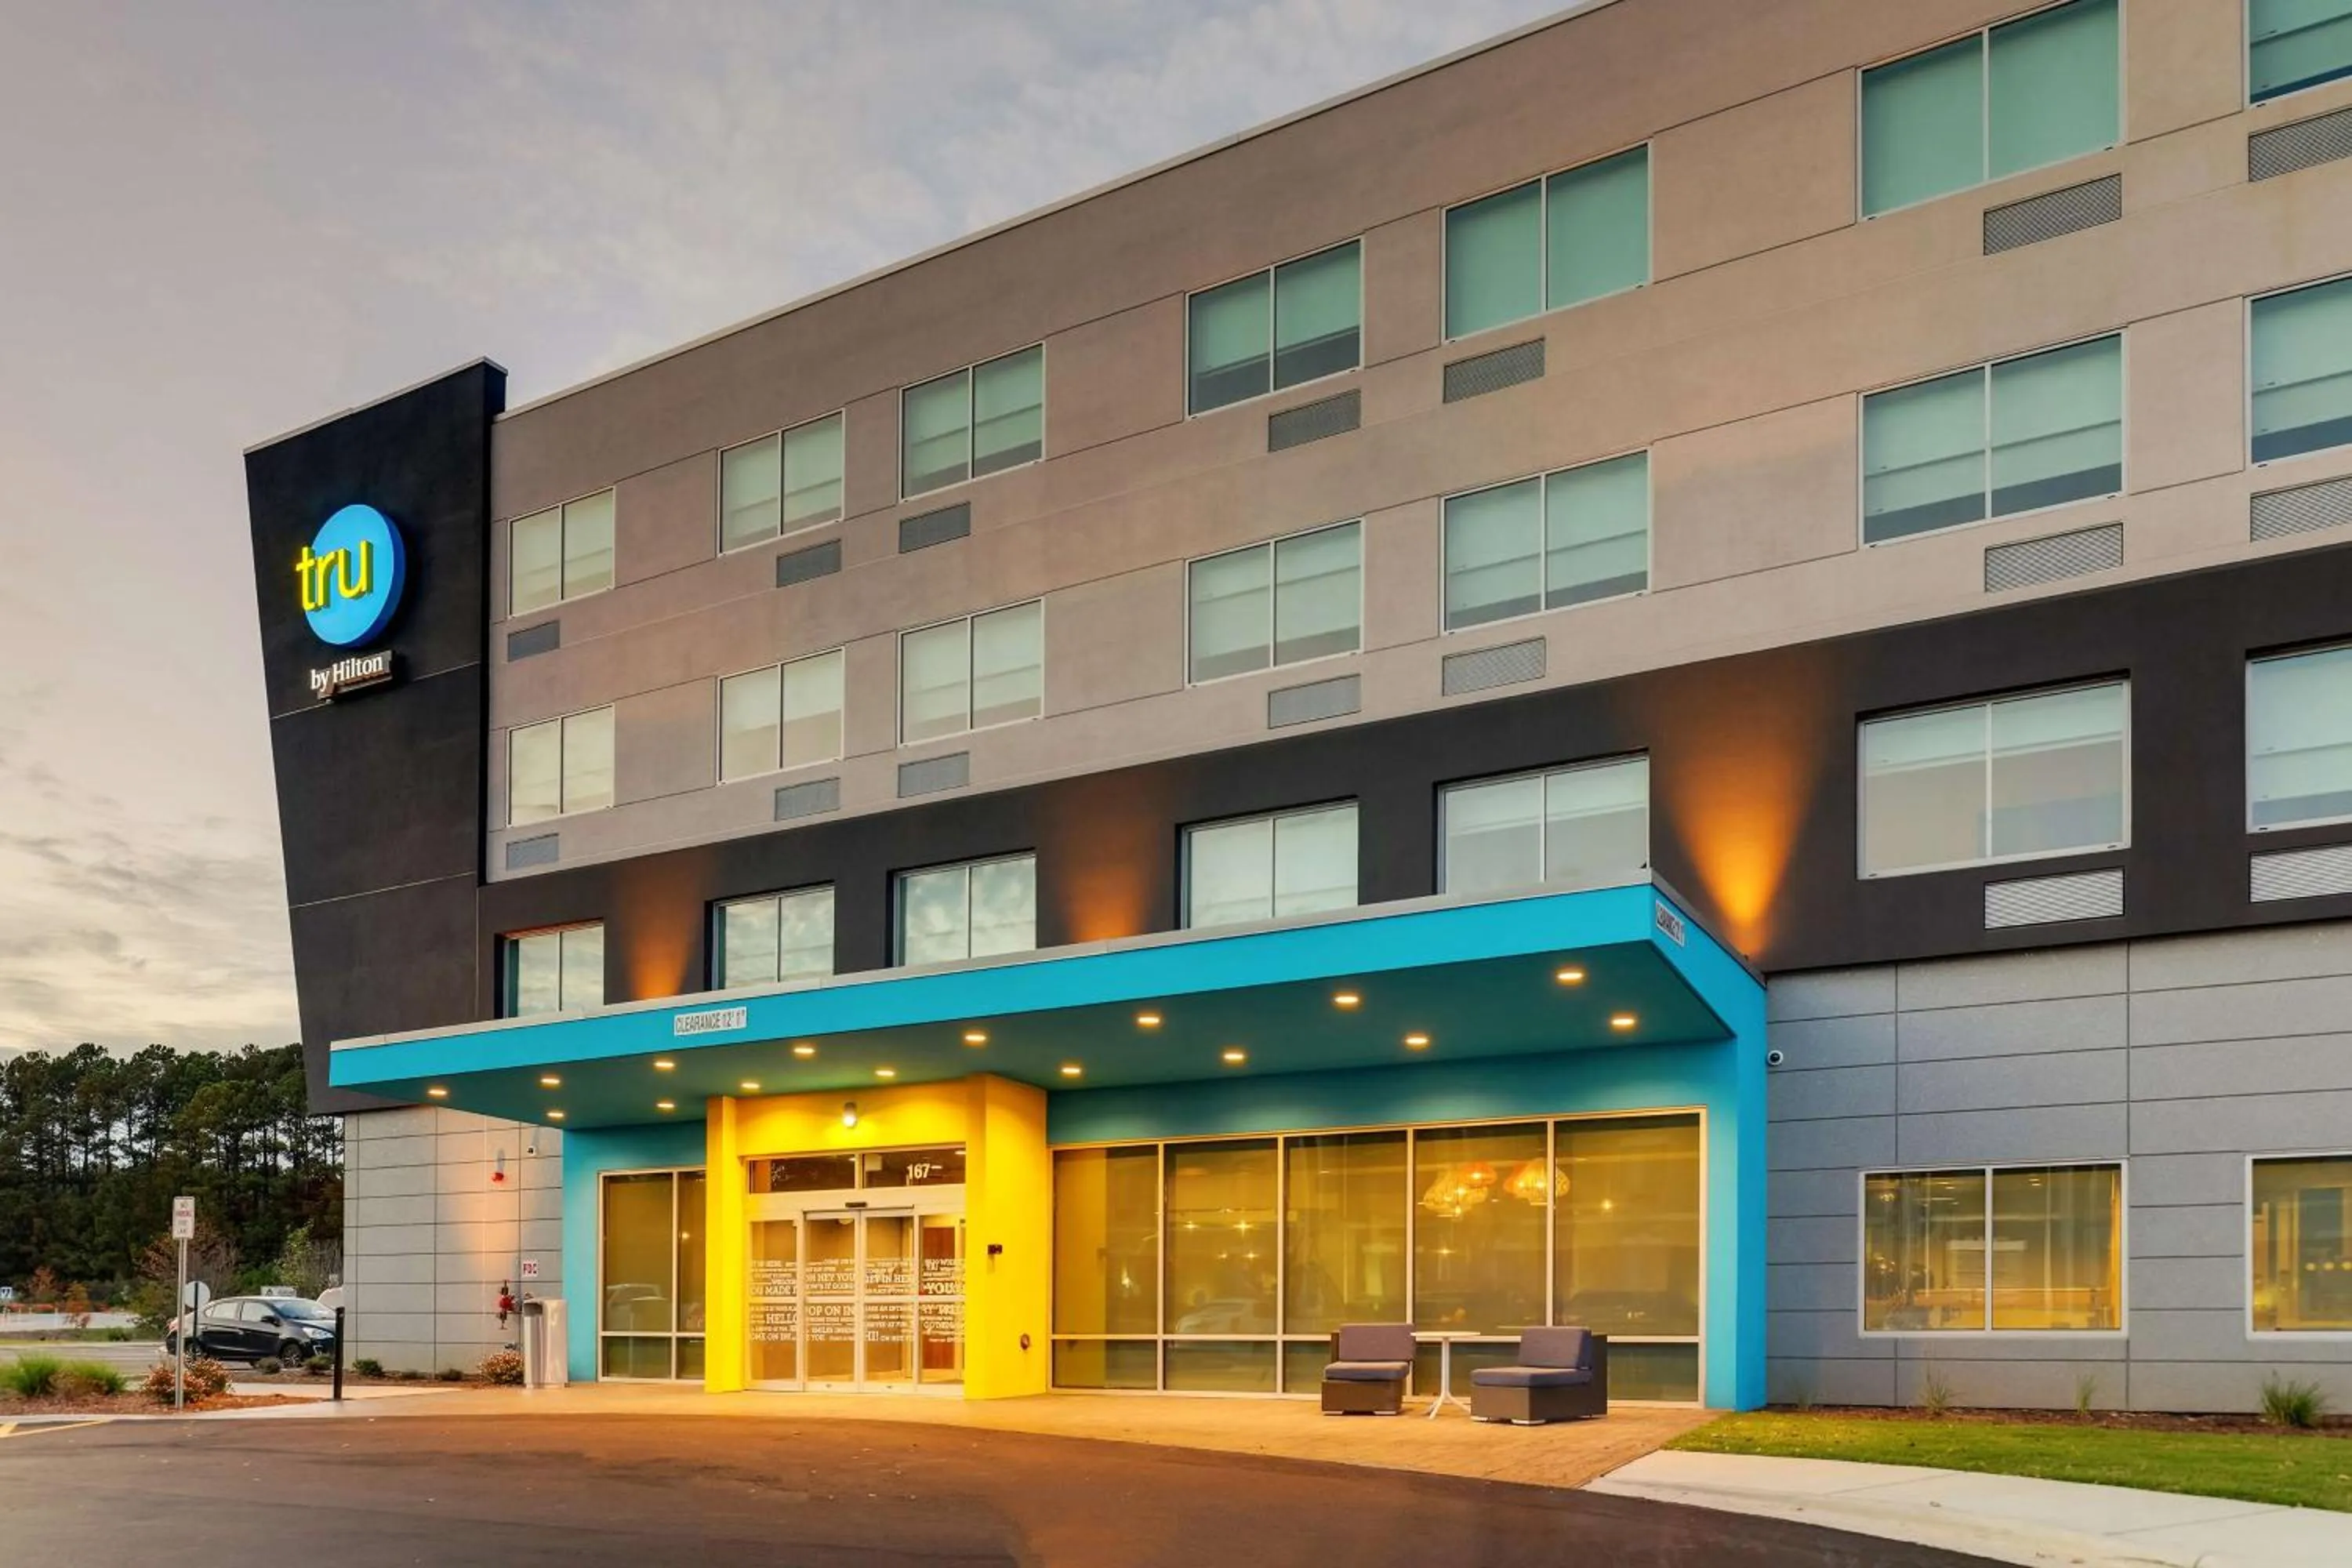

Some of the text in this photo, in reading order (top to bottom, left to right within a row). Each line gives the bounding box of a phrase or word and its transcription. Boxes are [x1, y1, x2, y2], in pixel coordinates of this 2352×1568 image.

[296, 540, 370, 611] tru
[310, 655, 383, 691] by Hilton
[677, 1011, 720, 1033] CLEARANCE
[907, 1163, 931, 1180] 167
[523, 1263, 537, 1275] FDC
[765, 1285, 792, 1295] MADE
[824, 1305, 841, 1316] ON
